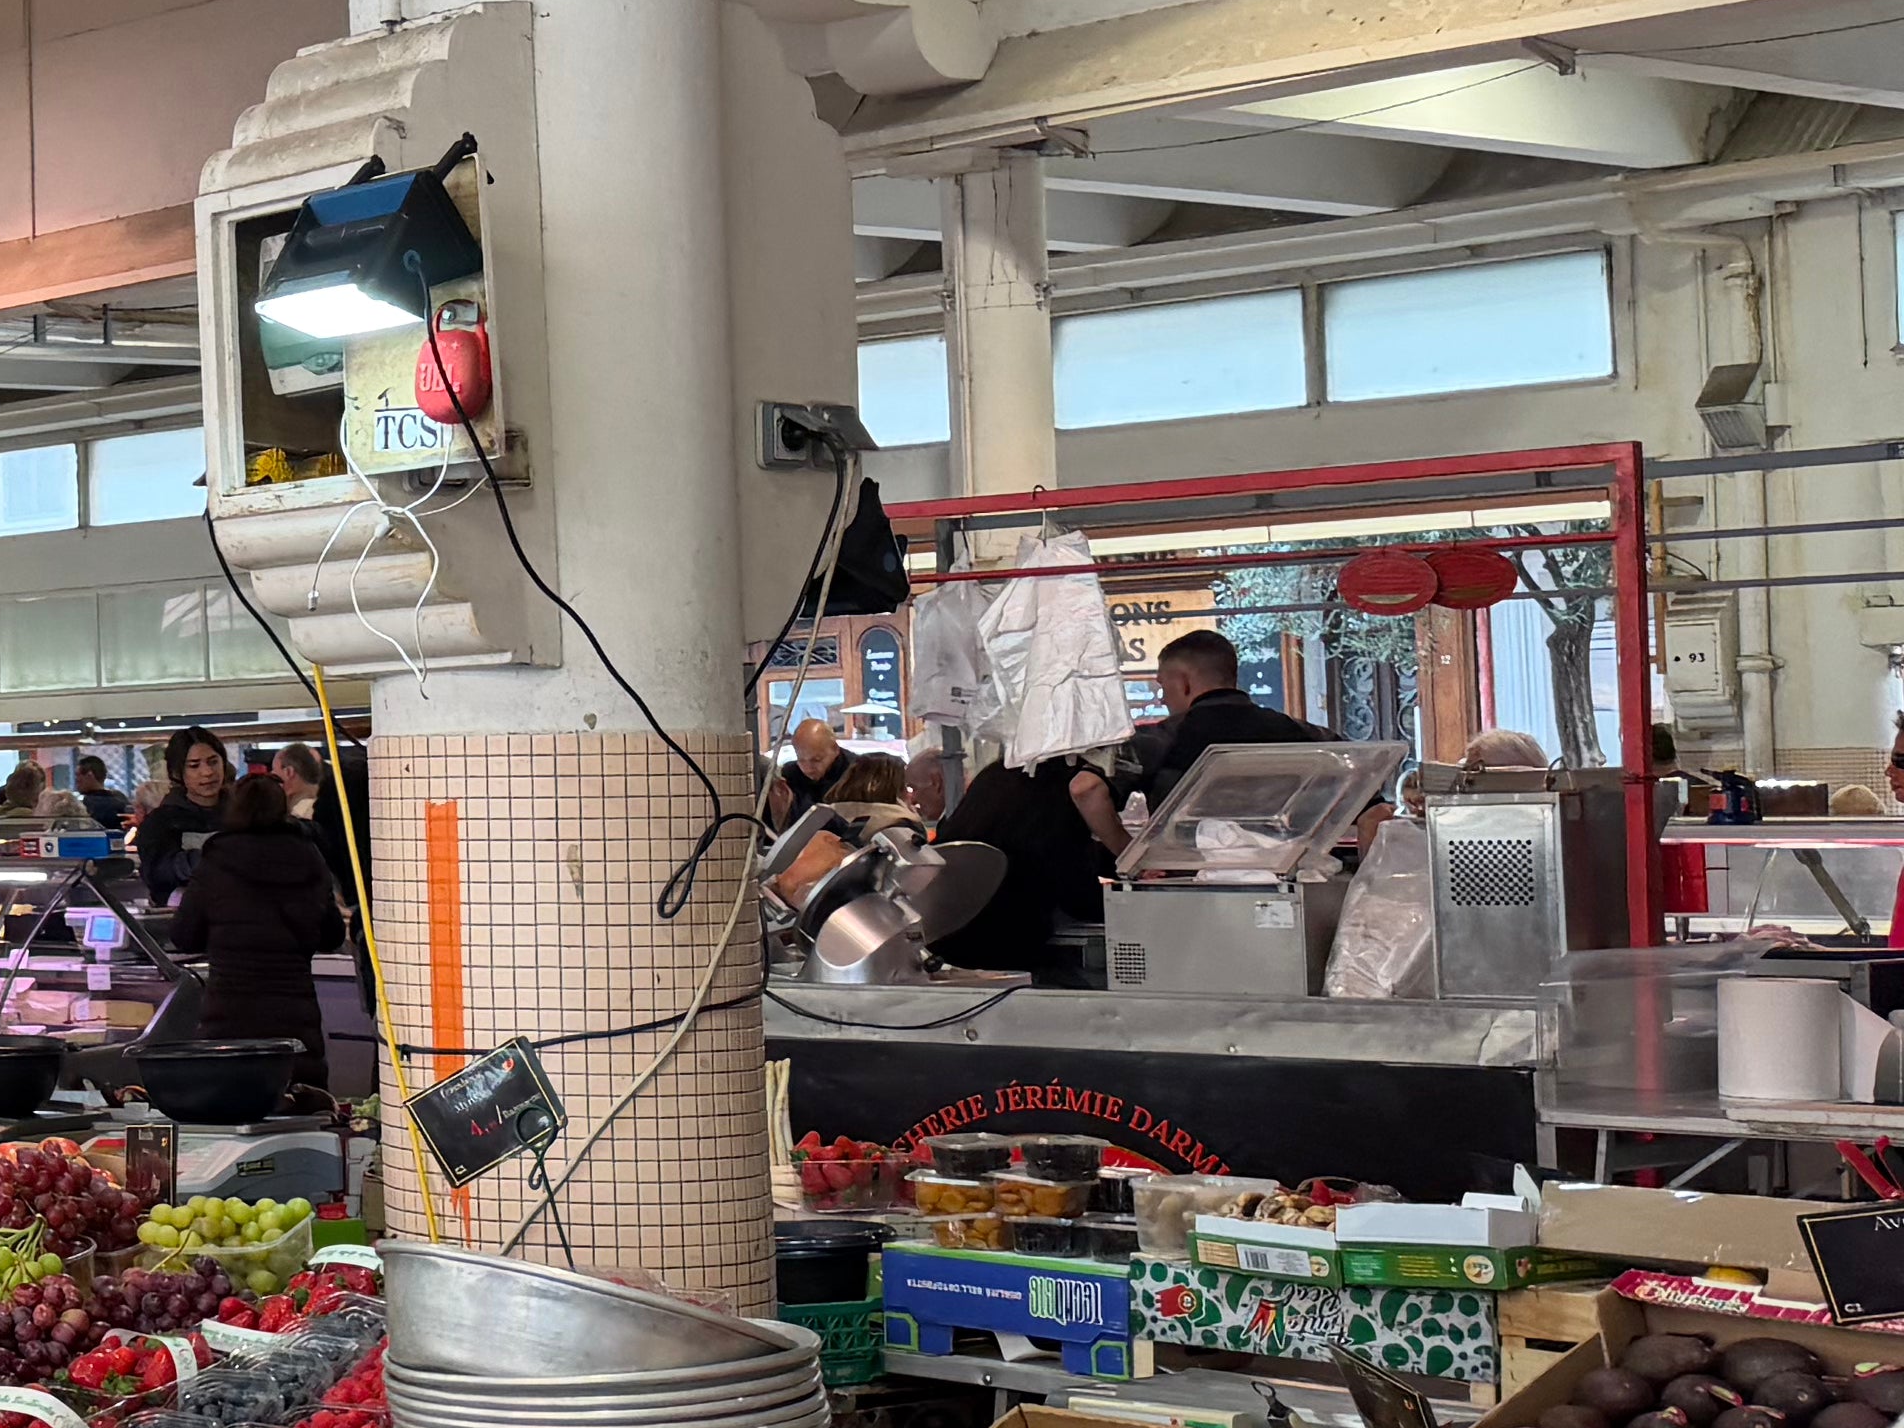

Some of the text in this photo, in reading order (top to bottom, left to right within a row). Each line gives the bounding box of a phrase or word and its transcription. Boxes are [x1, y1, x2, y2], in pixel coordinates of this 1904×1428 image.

[376, 413, 439, 450] TCS
[1688, 652, 1705, 663] 93
[993, 1078, 1123, 1121] JÉRÉMIE
